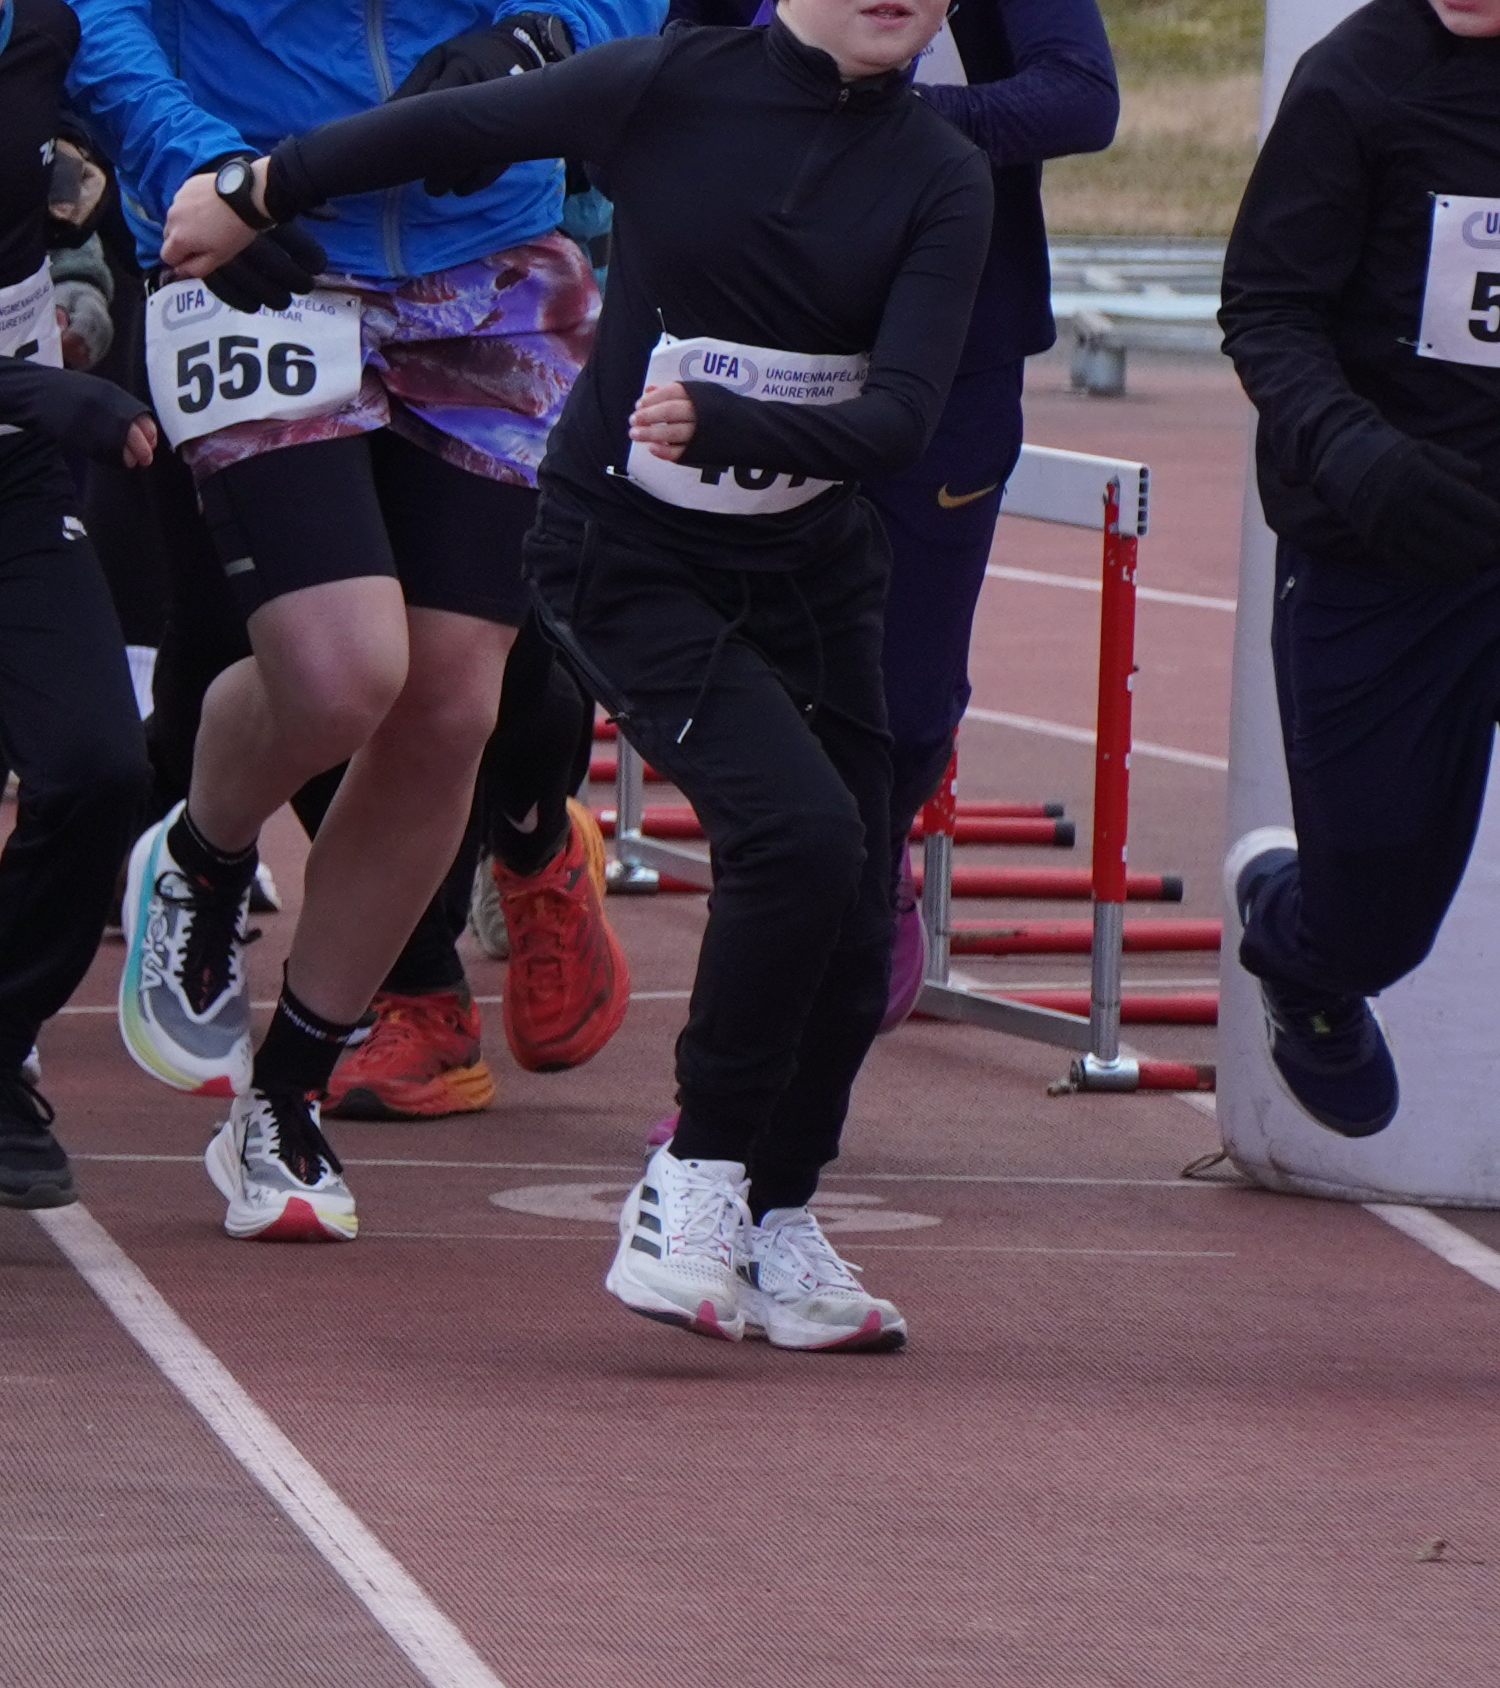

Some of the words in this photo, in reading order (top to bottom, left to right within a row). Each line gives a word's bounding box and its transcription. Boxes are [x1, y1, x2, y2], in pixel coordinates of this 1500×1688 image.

[176, 288, 205, 314] UFA
[177, 334, 318, 414] 556
[702, 351, 740, 379] UFA
[761, 385, 834, 398] AKUREYRAR
